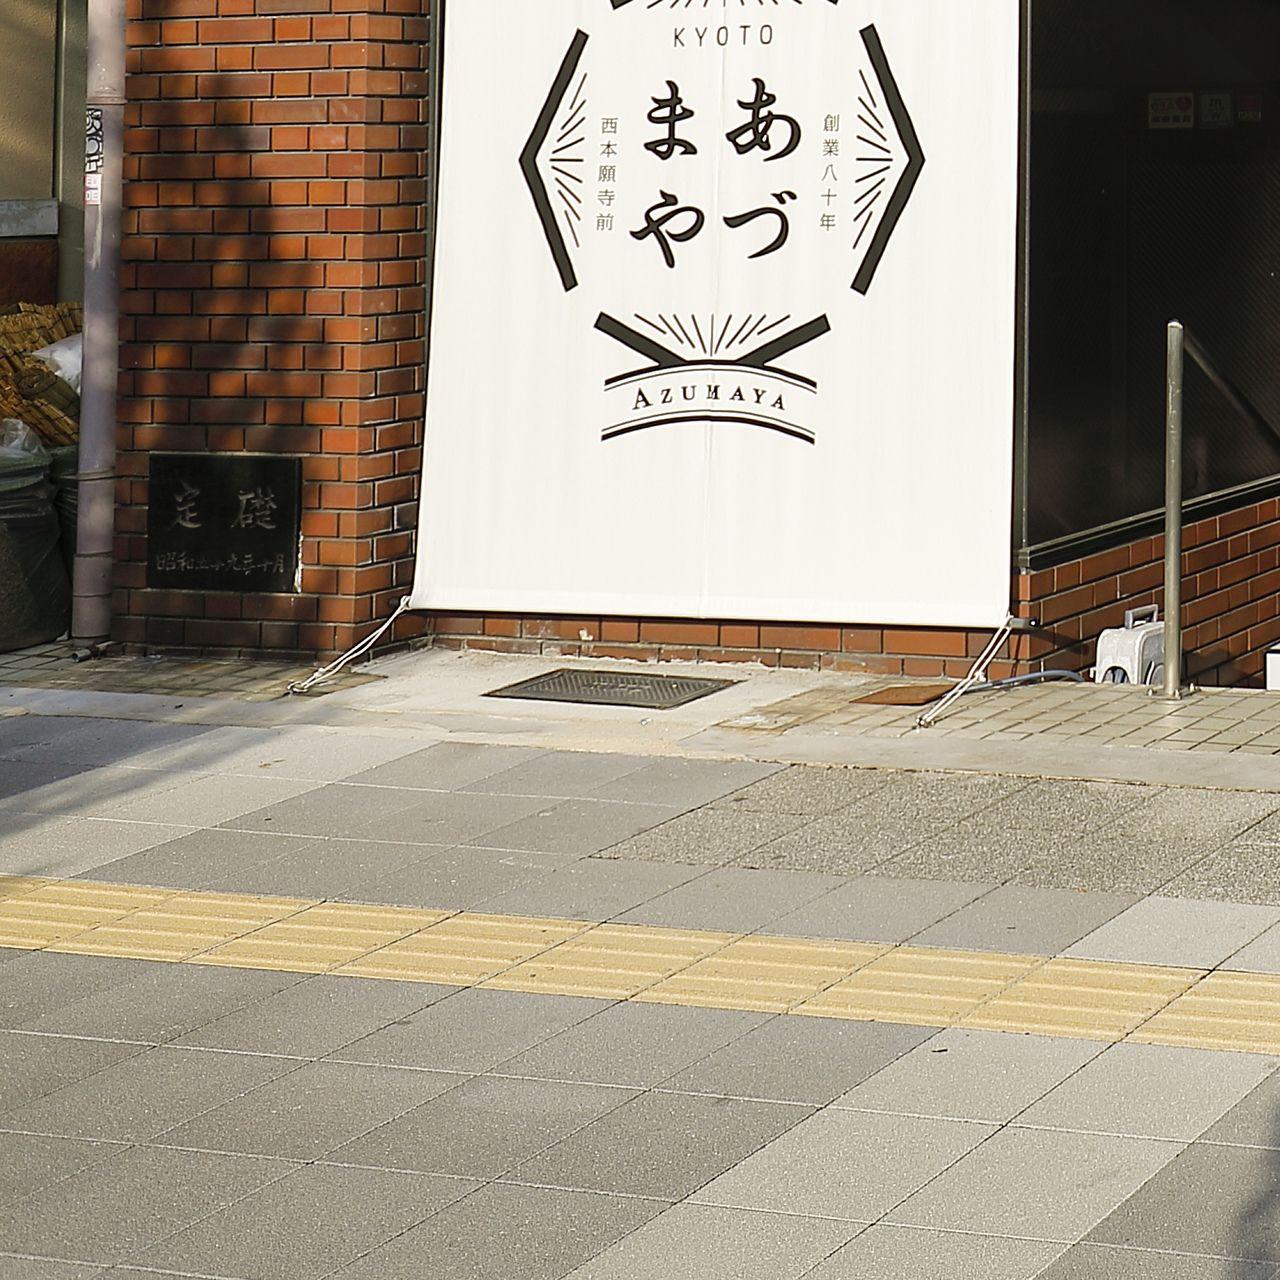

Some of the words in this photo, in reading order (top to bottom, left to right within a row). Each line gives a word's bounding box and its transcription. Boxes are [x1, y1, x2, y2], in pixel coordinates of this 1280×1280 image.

[672, 24, 774, 48] KYOTO
[595, 116, 619, 232] 西本願寺前
[819, 113, 841, 232] 創業八十年
[631, 384, 787, 411] AZUMAYA
[168, 480, 278, 530] 定礎
